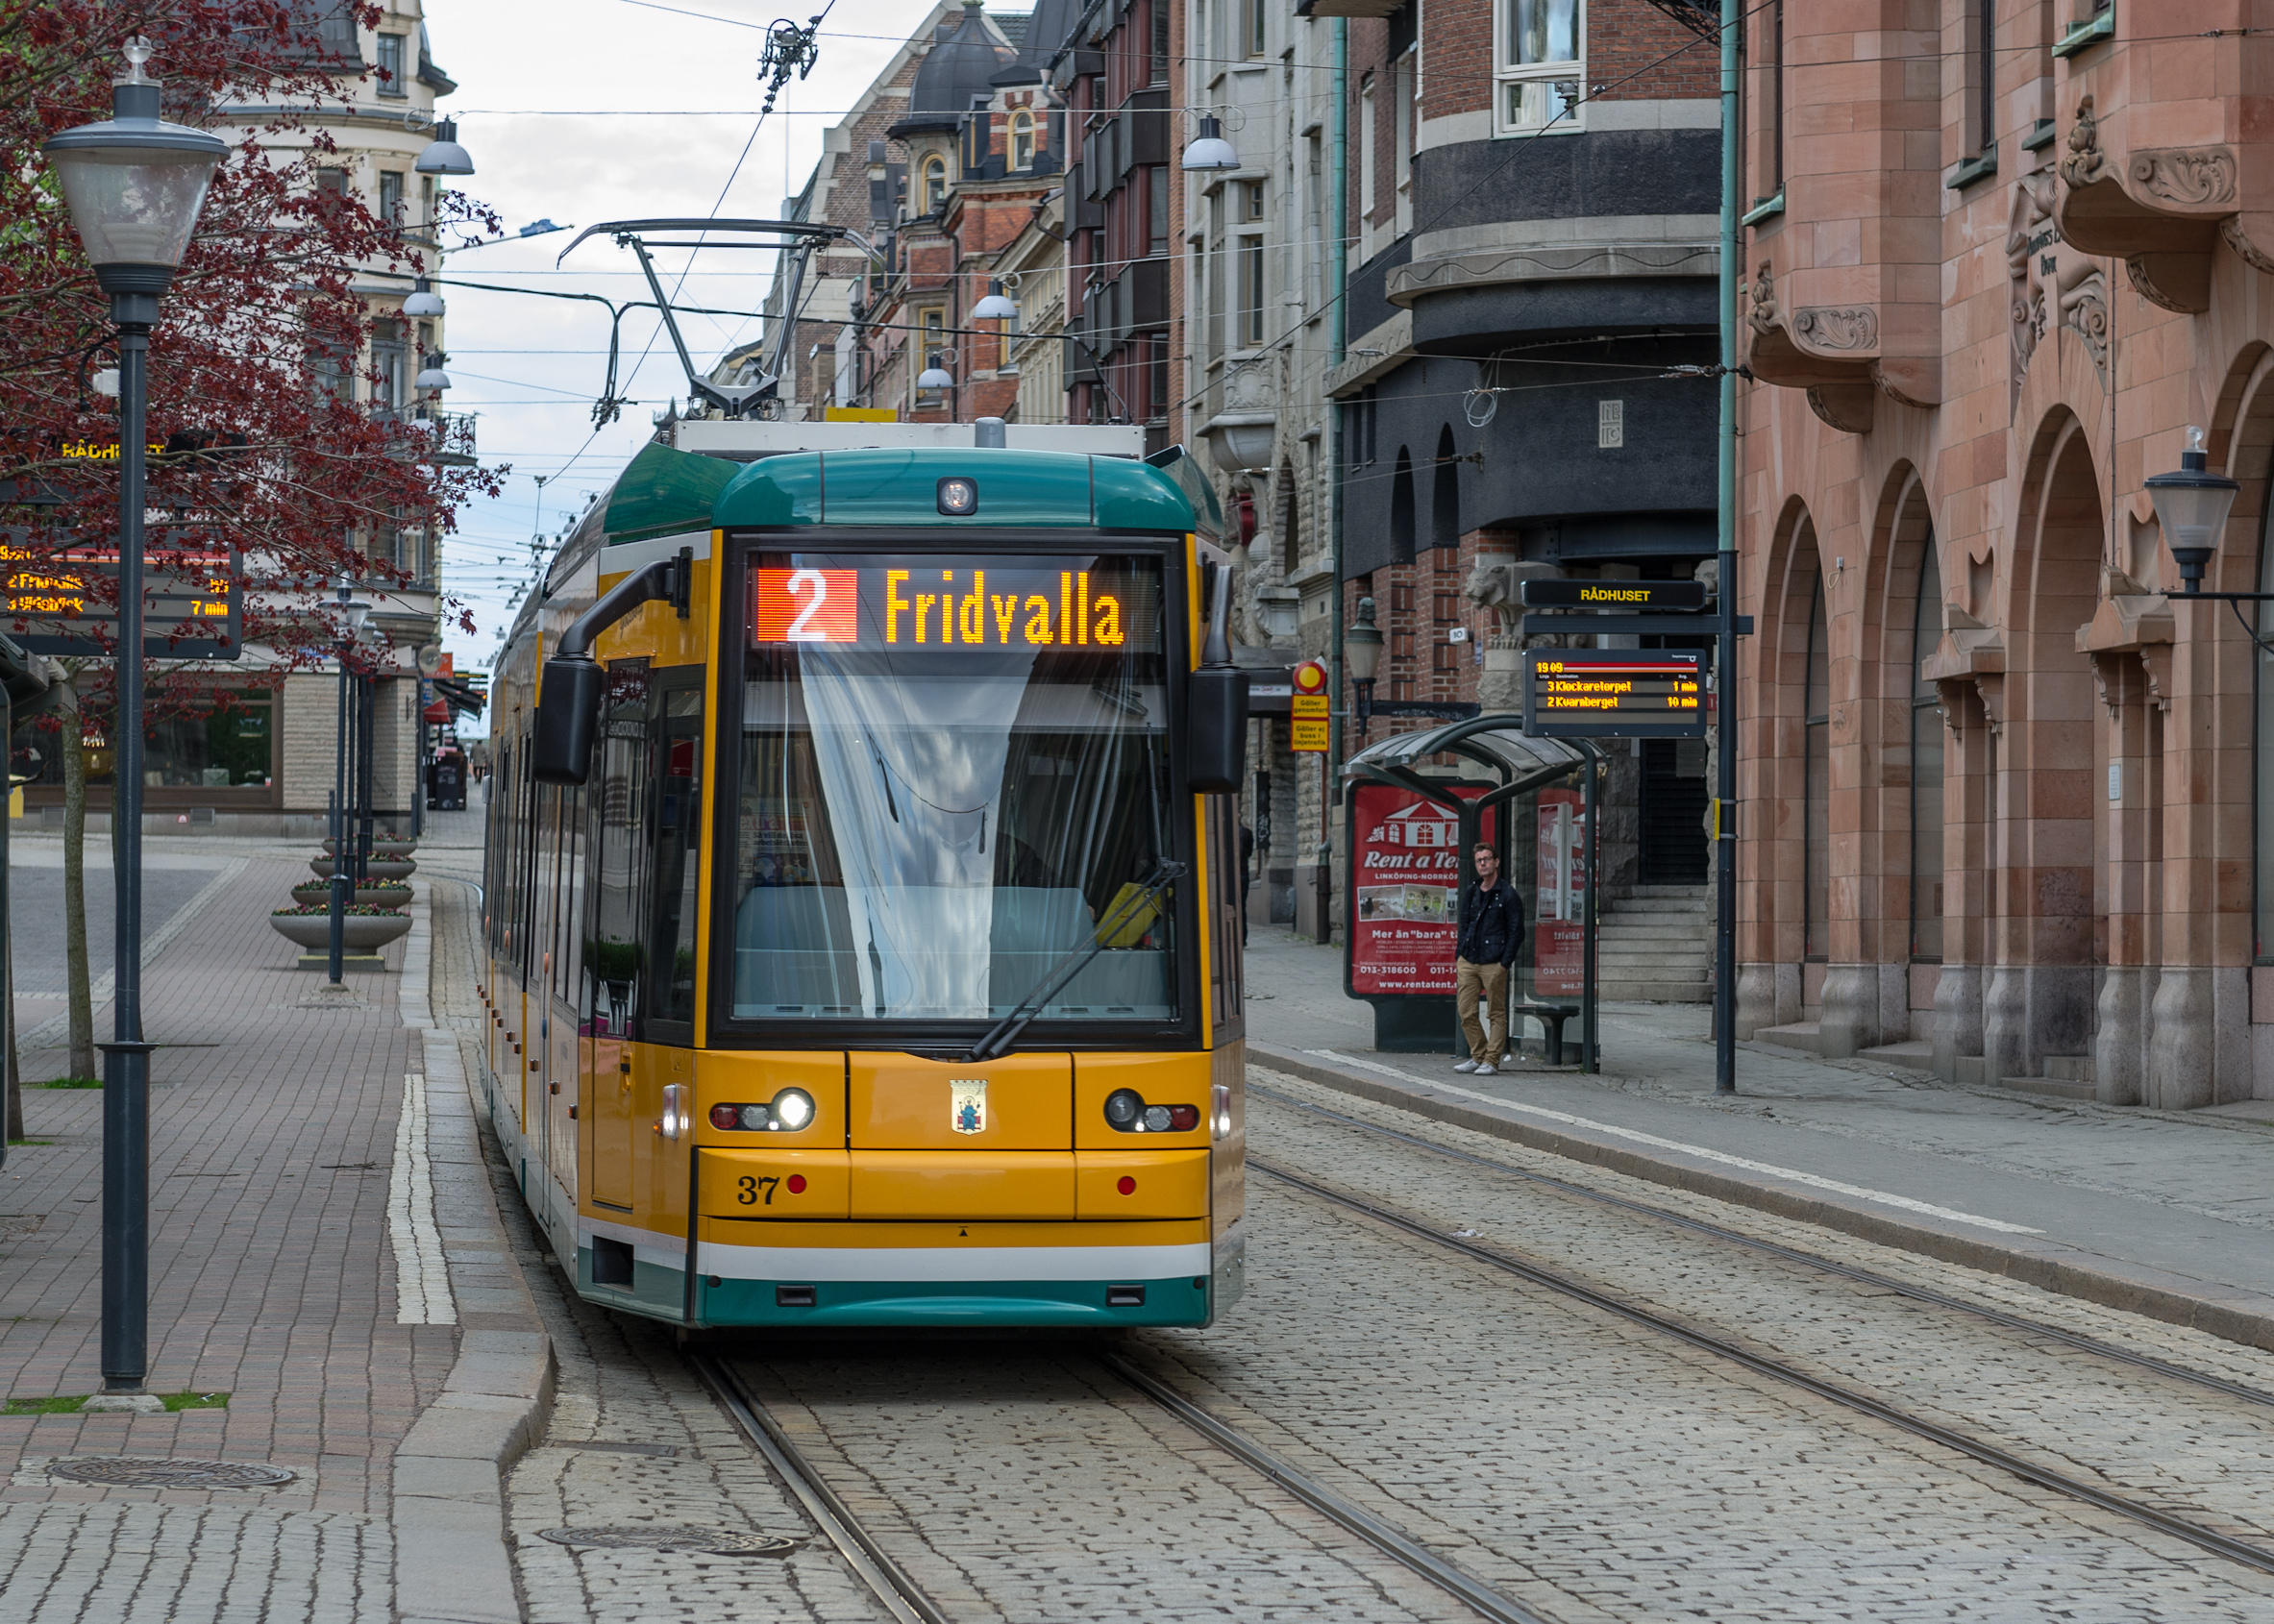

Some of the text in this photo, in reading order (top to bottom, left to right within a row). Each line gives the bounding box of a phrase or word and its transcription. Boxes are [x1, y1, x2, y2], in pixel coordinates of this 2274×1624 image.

[62, 438, 165, 458] RÅDHT
[1580, 586, 1651, 602] RÅDHUSET
[191, 601, 201, 615] 7
[205, 602, 229, 616] min
[786, 568, 1125, 645] 2 Fridvalla
[1547, 680, 1697, 694] 3 Klockaretorpet 1 min
[1547, 696, 1697, 709] 2 Kvarnberget 10 min
[1364, 850, 1414, 869] Rent
[1415, 855, 1430, 869] a
[1396, 929, 1409, 938] än
[737, 1175, 779, 1205] 37
